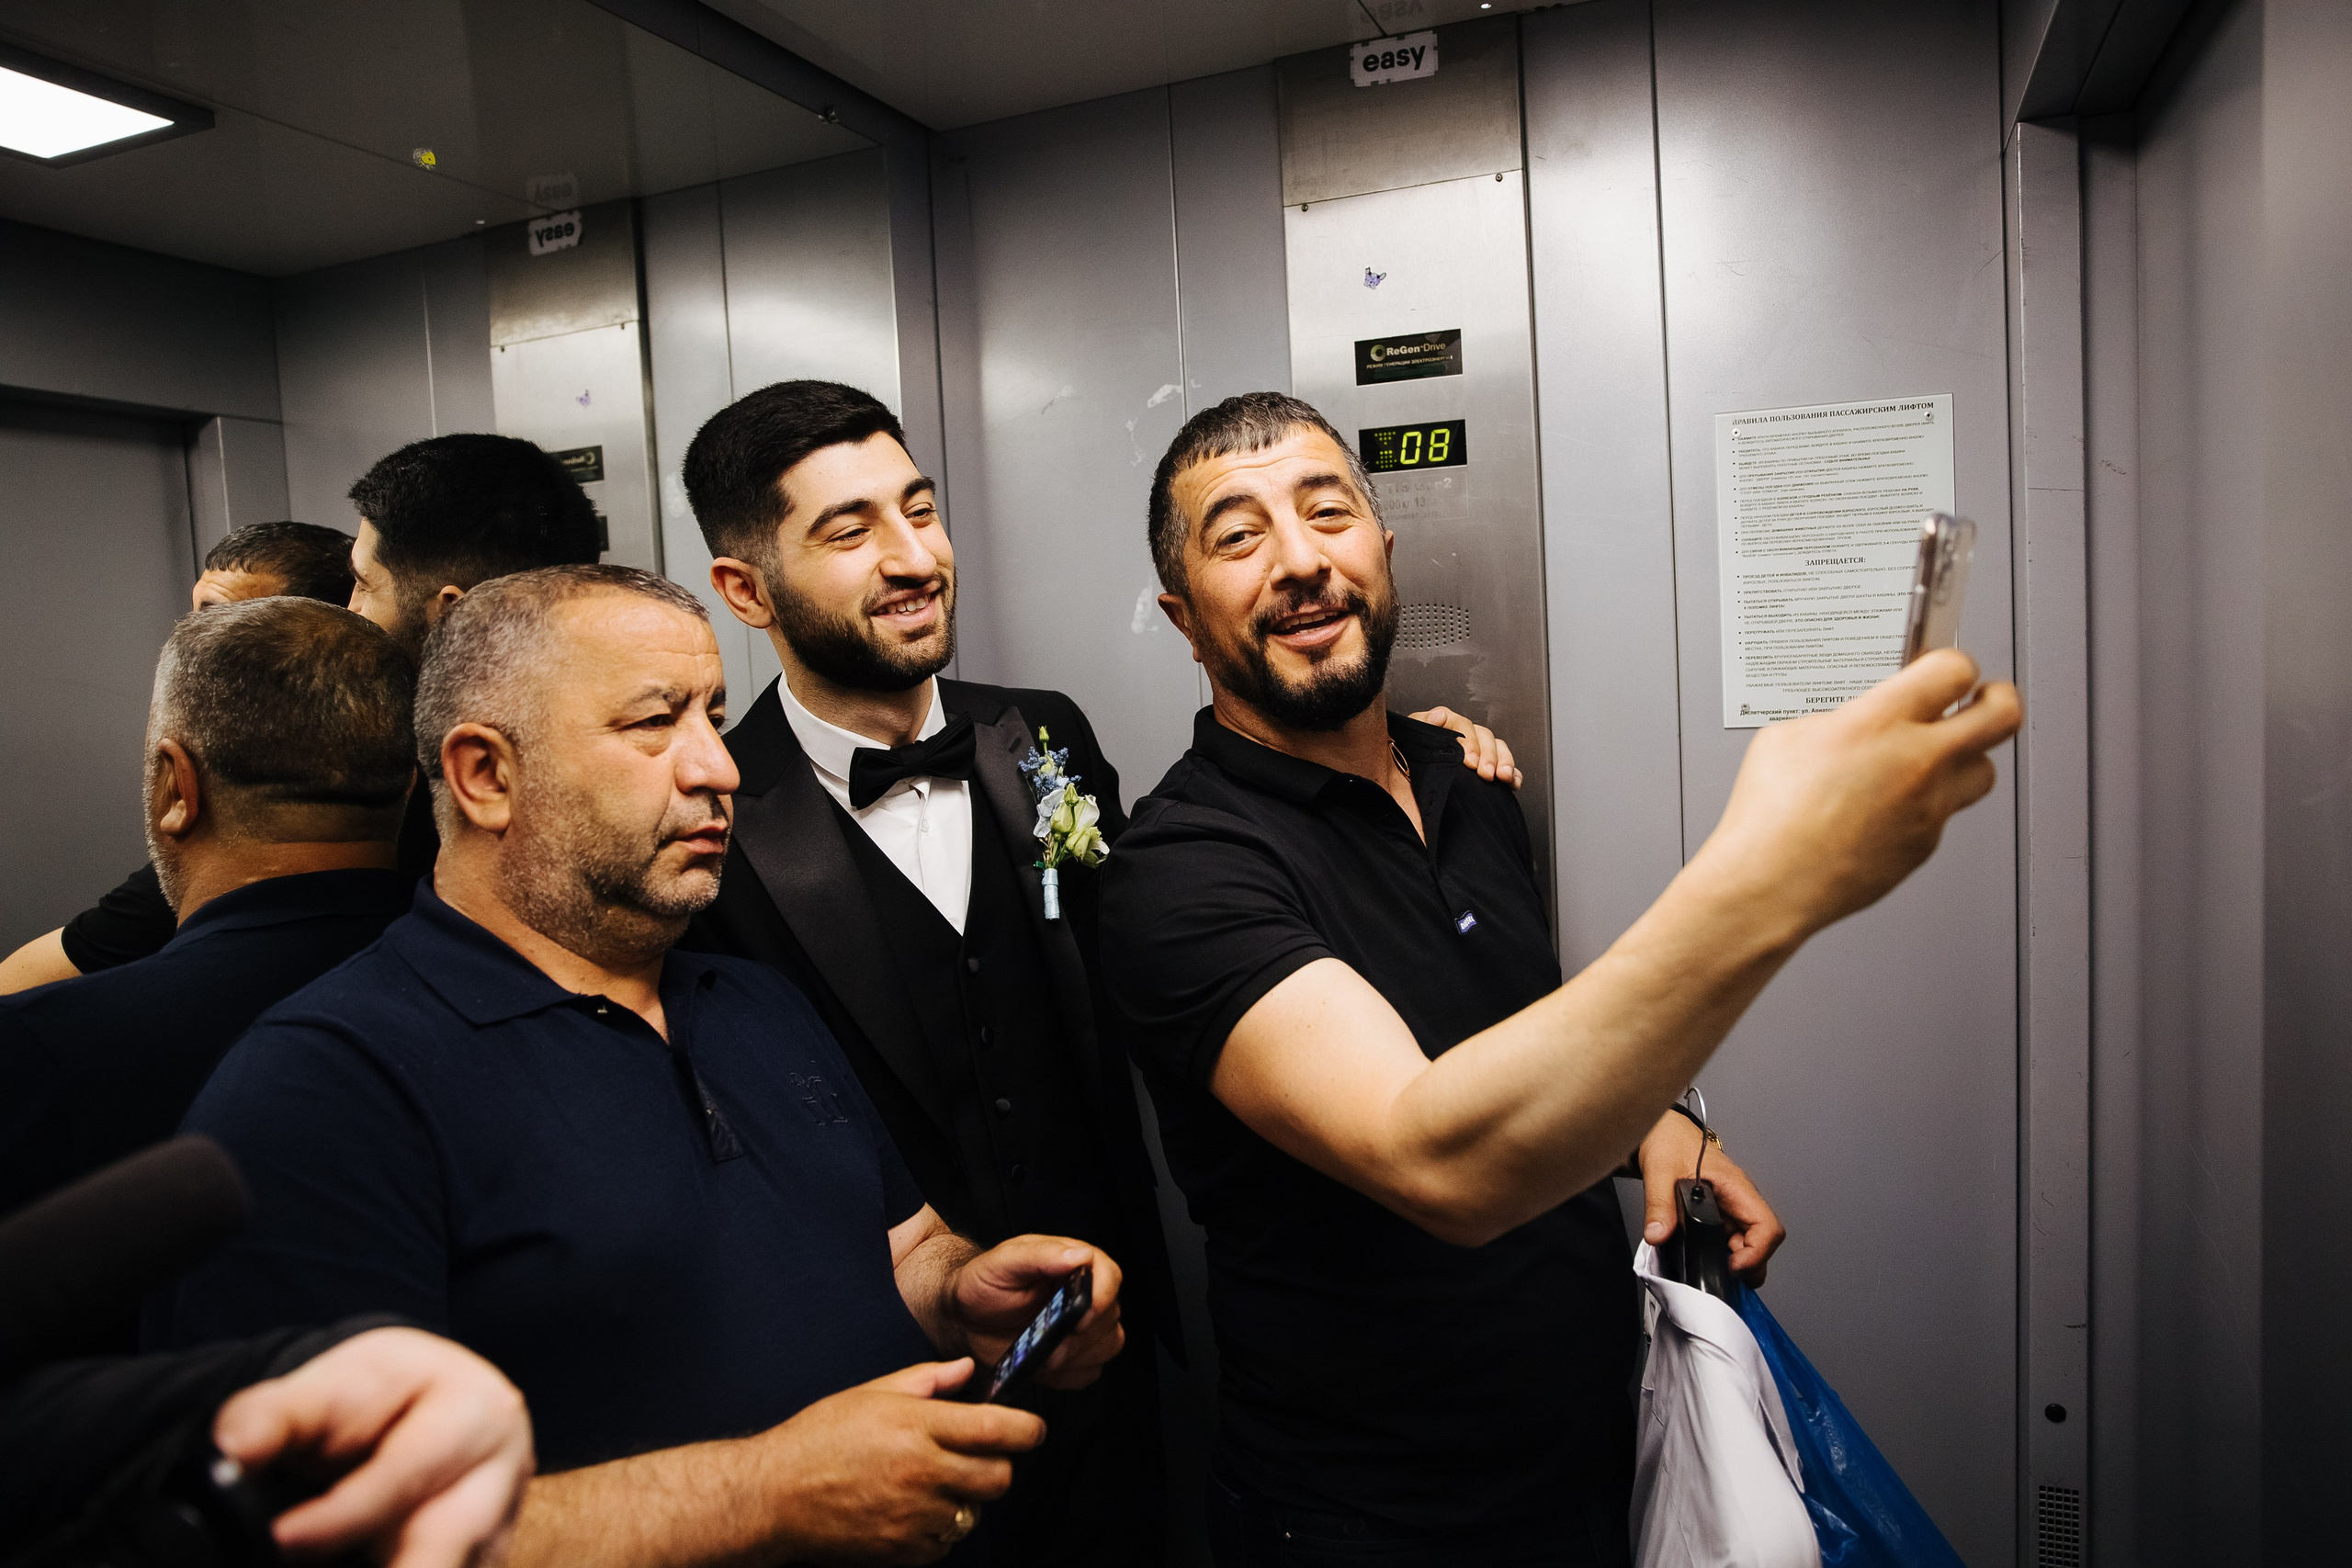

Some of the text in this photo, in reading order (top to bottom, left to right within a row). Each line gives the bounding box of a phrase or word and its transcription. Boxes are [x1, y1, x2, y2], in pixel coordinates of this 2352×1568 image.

[1363, 45, 1426, 72] easy
[1770, 412, 1827, 423] ПОЛЬЗОВАНИЯ
[1829, 406, 1896, 417] ПАССАЖИРСКИМ
[1898, 402, 1934, 412] ЛИФТОМ
[1399, 427, 1451, 466] 08
[1805, 557, 1866, 567] ЗАПРЕЩАЕТСЯ:
[1740, 708, 1781, 716] Диспетчерский
